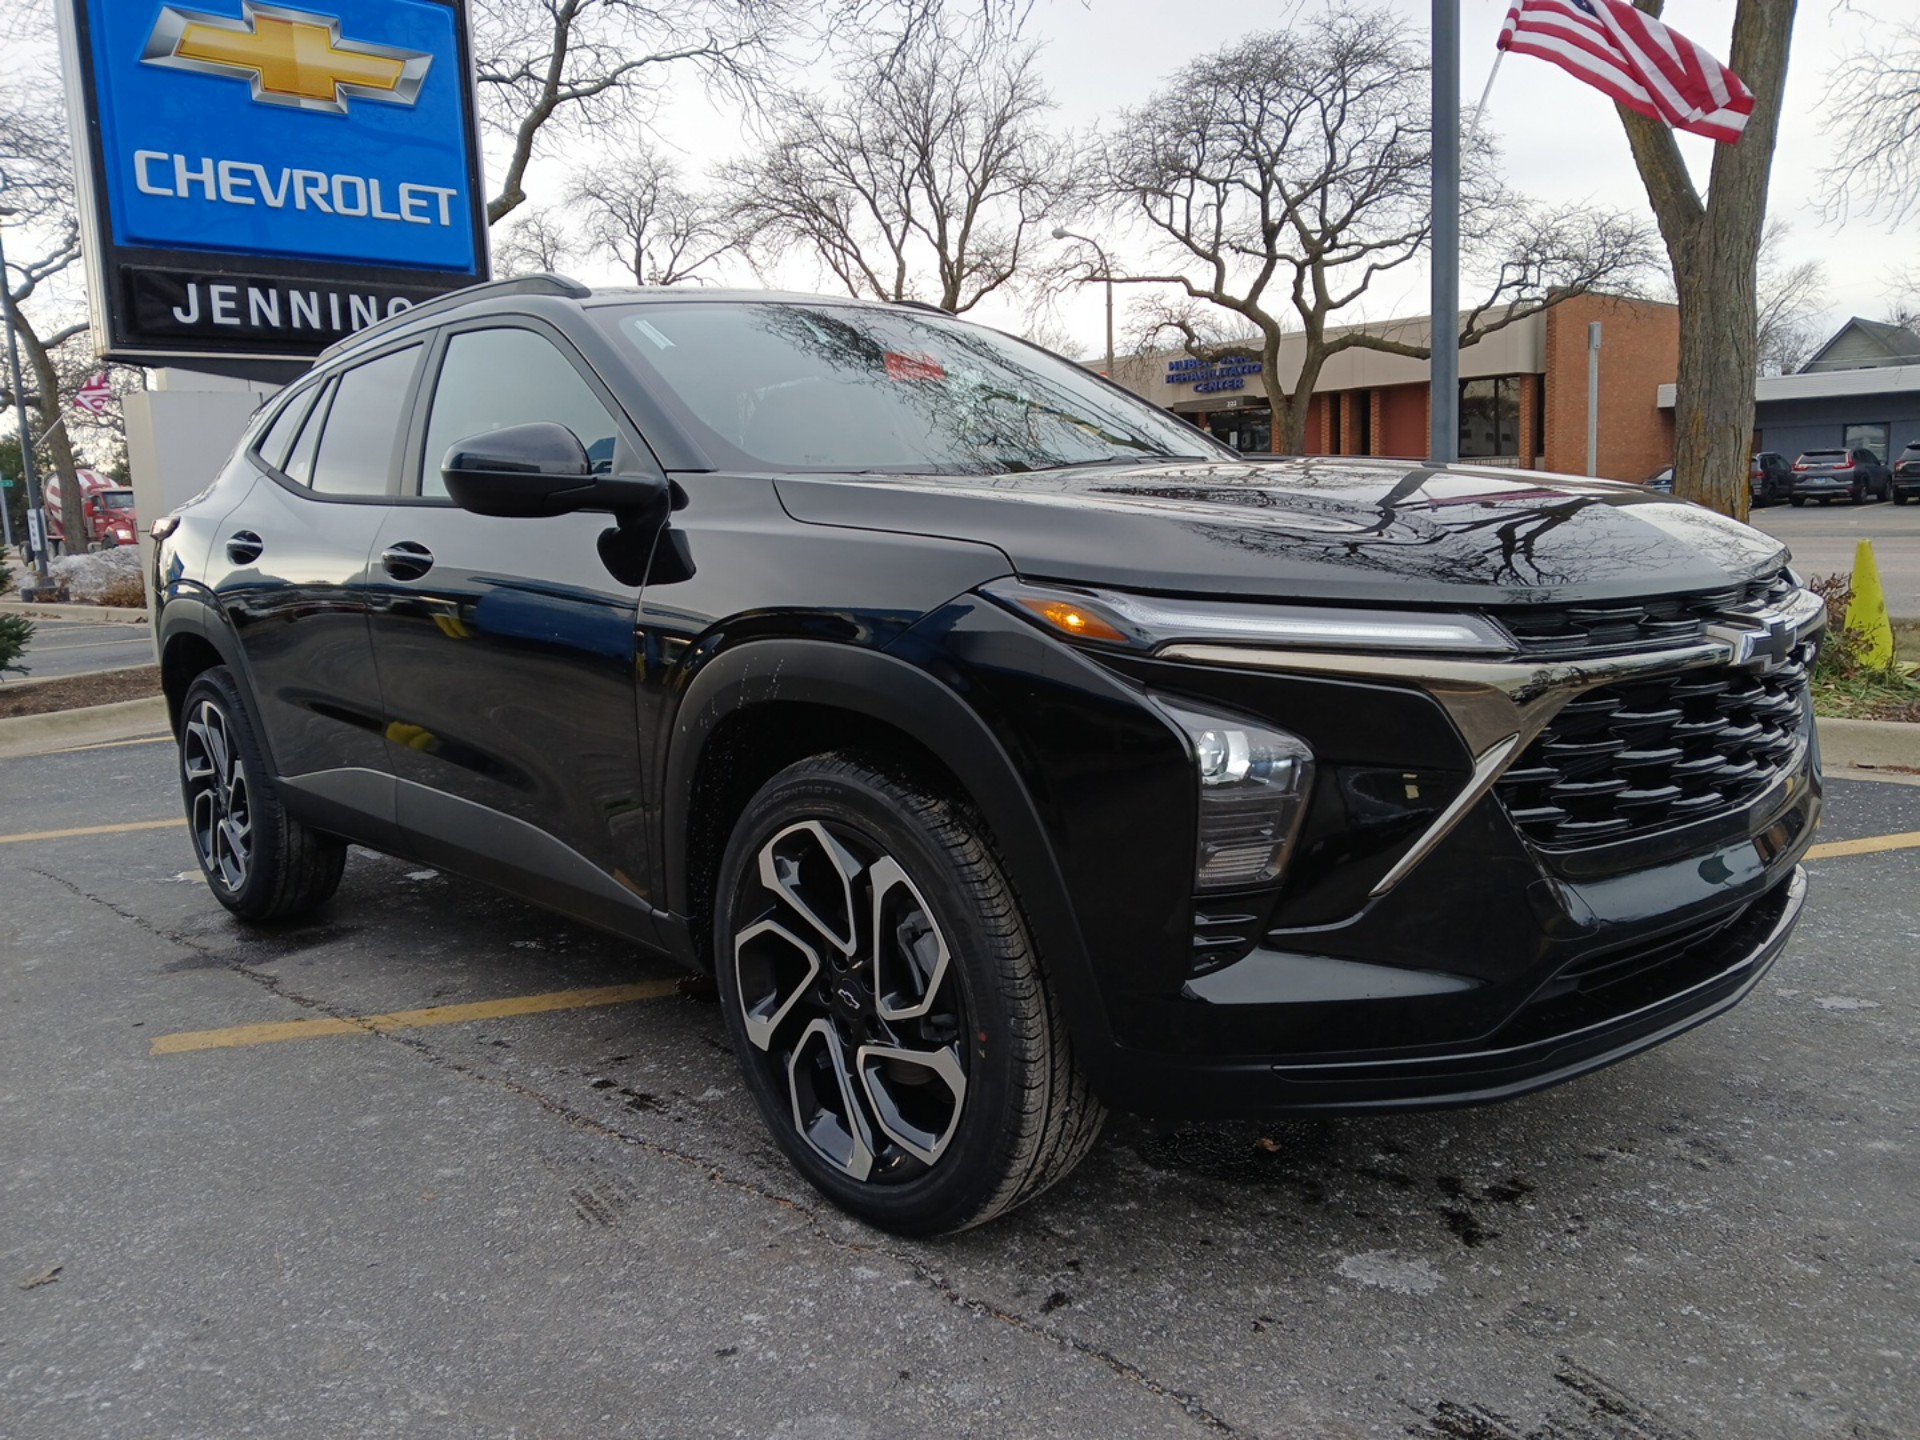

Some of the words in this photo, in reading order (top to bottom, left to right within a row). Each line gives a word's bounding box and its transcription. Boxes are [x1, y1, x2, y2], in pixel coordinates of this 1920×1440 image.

[133, 149, 458, 226] CHEVROLET
[1165, 362, 1263, 384] REHABILITATIO
[1193, 378, 1245, 393] CENTER
